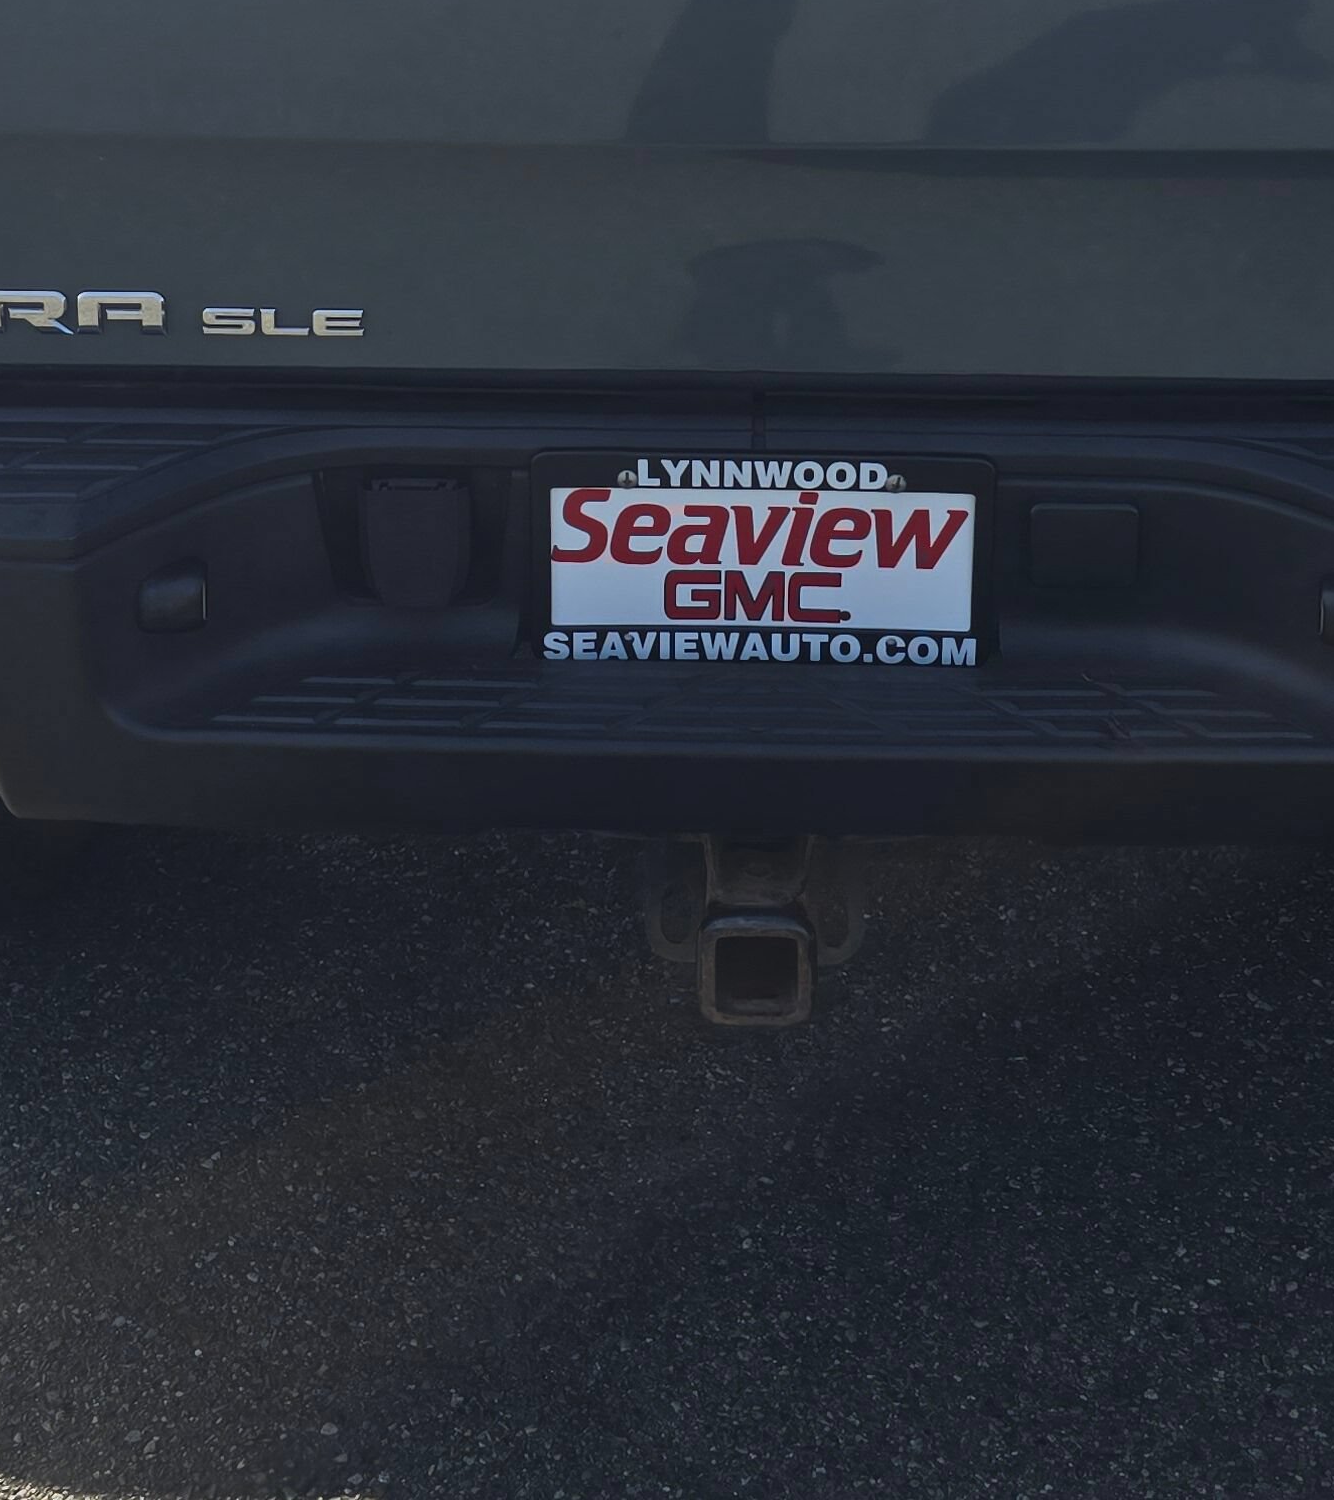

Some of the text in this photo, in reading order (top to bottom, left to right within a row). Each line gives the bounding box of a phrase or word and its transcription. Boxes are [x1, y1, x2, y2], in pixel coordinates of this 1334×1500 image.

[201, 307, 365, 336] SLE
[637, 458, 889, 490] LYNNWOOD
[550, 488, 969, 570] Seaview
[663, 569, 843, 623] GMC
[543, 631, 978, 667] SEAVIEWAUTO.COM
